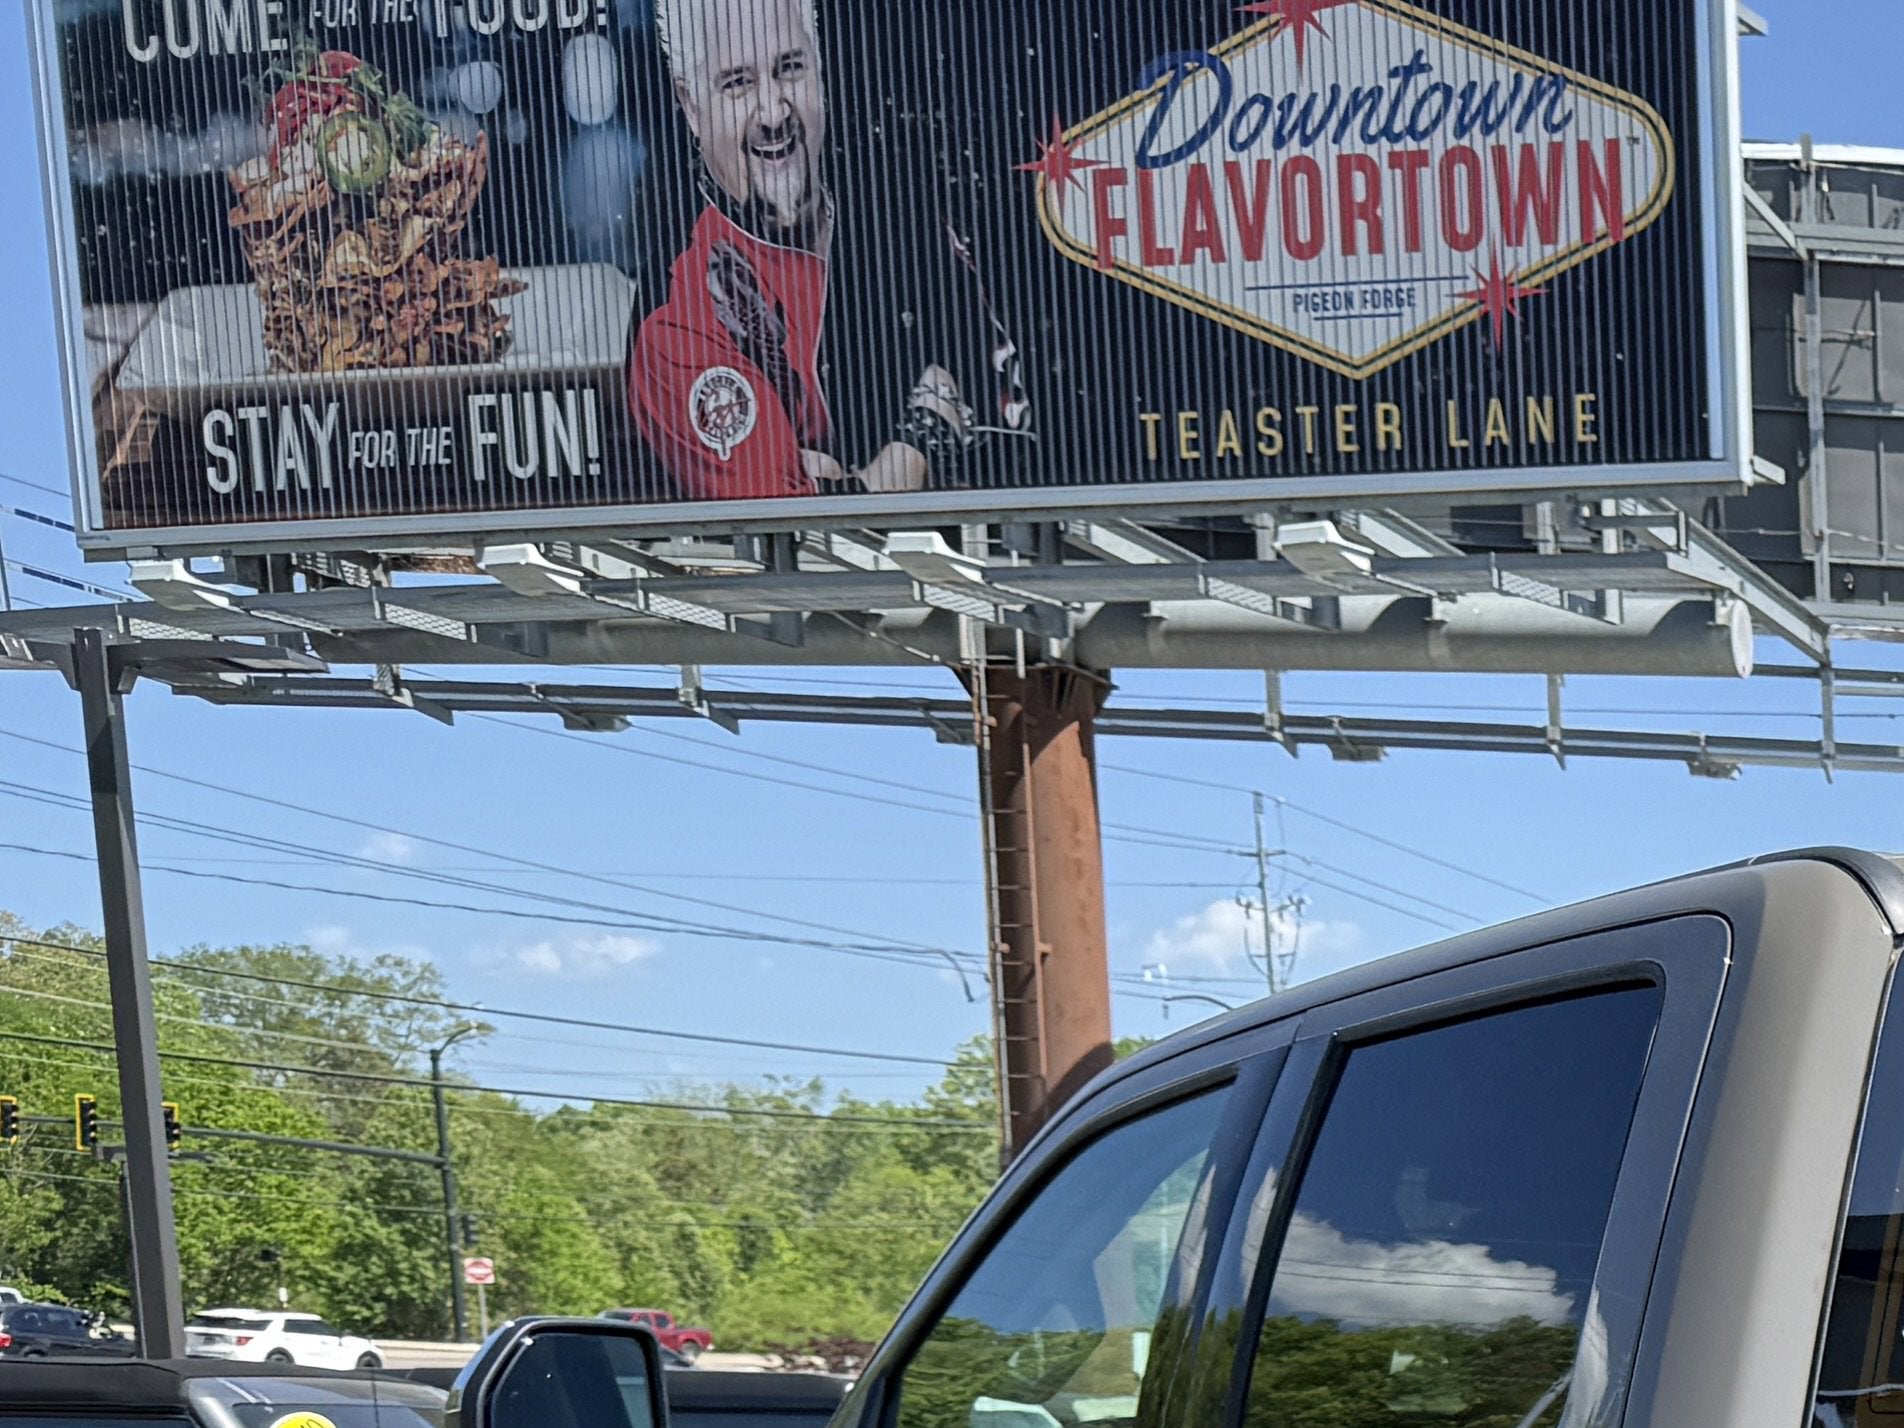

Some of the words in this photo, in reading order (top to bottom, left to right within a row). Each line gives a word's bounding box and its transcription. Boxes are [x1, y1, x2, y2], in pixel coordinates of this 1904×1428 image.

[1136, 47, 1574, 170] Downtown
[1091, 136, 1625, 270] FLAVORTOWN
[1292, 289, 1355, 313] PIGEON
[1361, 286, 1417, 310] FORGE
[202, 402, 340, 494] STAY
[349, 429, 397, 470] FOR
[406, 426, 453, 467] THE
[468, 388, 601, 482] FUN!
[1139, 401, 1402, 461] TEASTER
[1446, 393, 1598, 448] LANE
